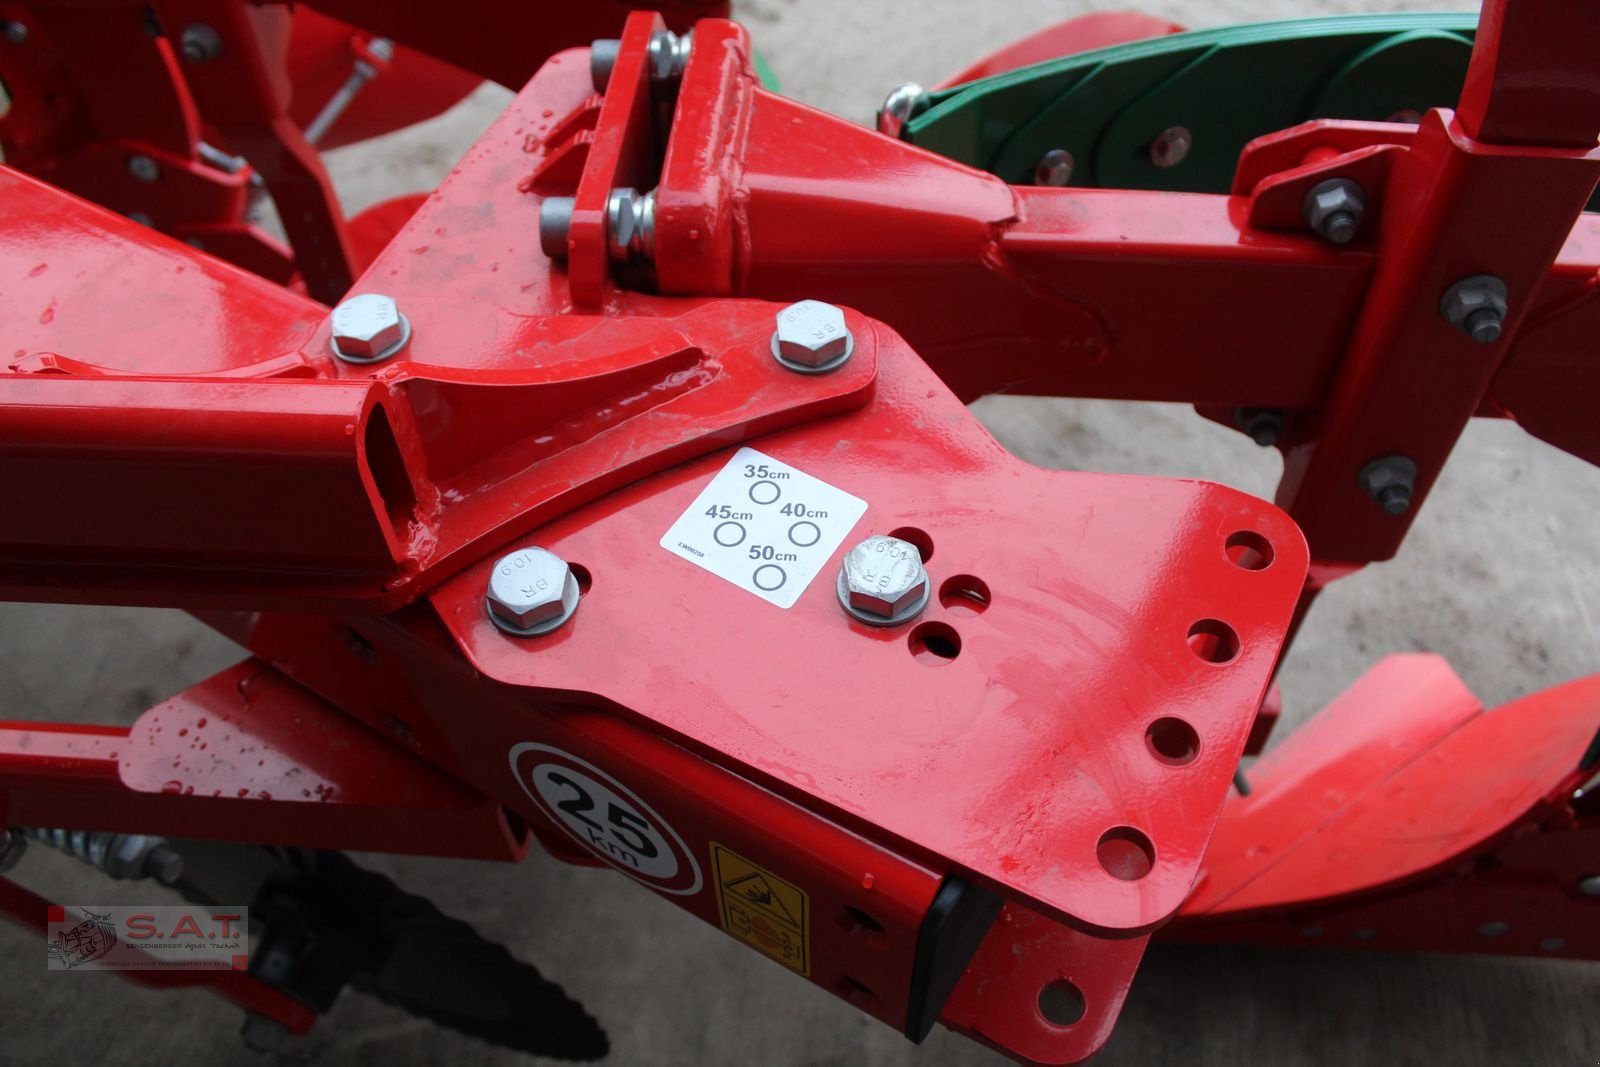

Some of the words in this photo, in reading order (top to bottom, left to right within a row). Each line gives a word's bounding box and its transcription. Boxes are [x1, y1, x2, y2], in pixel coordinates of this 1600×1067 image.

[743, 464, 790, 480] 35cm
[704, 504, 753, 521] 45cm
[779, 502, 828, 519] 40cm
[748, 544, 798, 562] 50cm
[501, 553, 532, 576] 10.9
[520, 578, 549, 599] BR
[547, 771, 659, 859] 25
[587, 827, 639, 868] km
